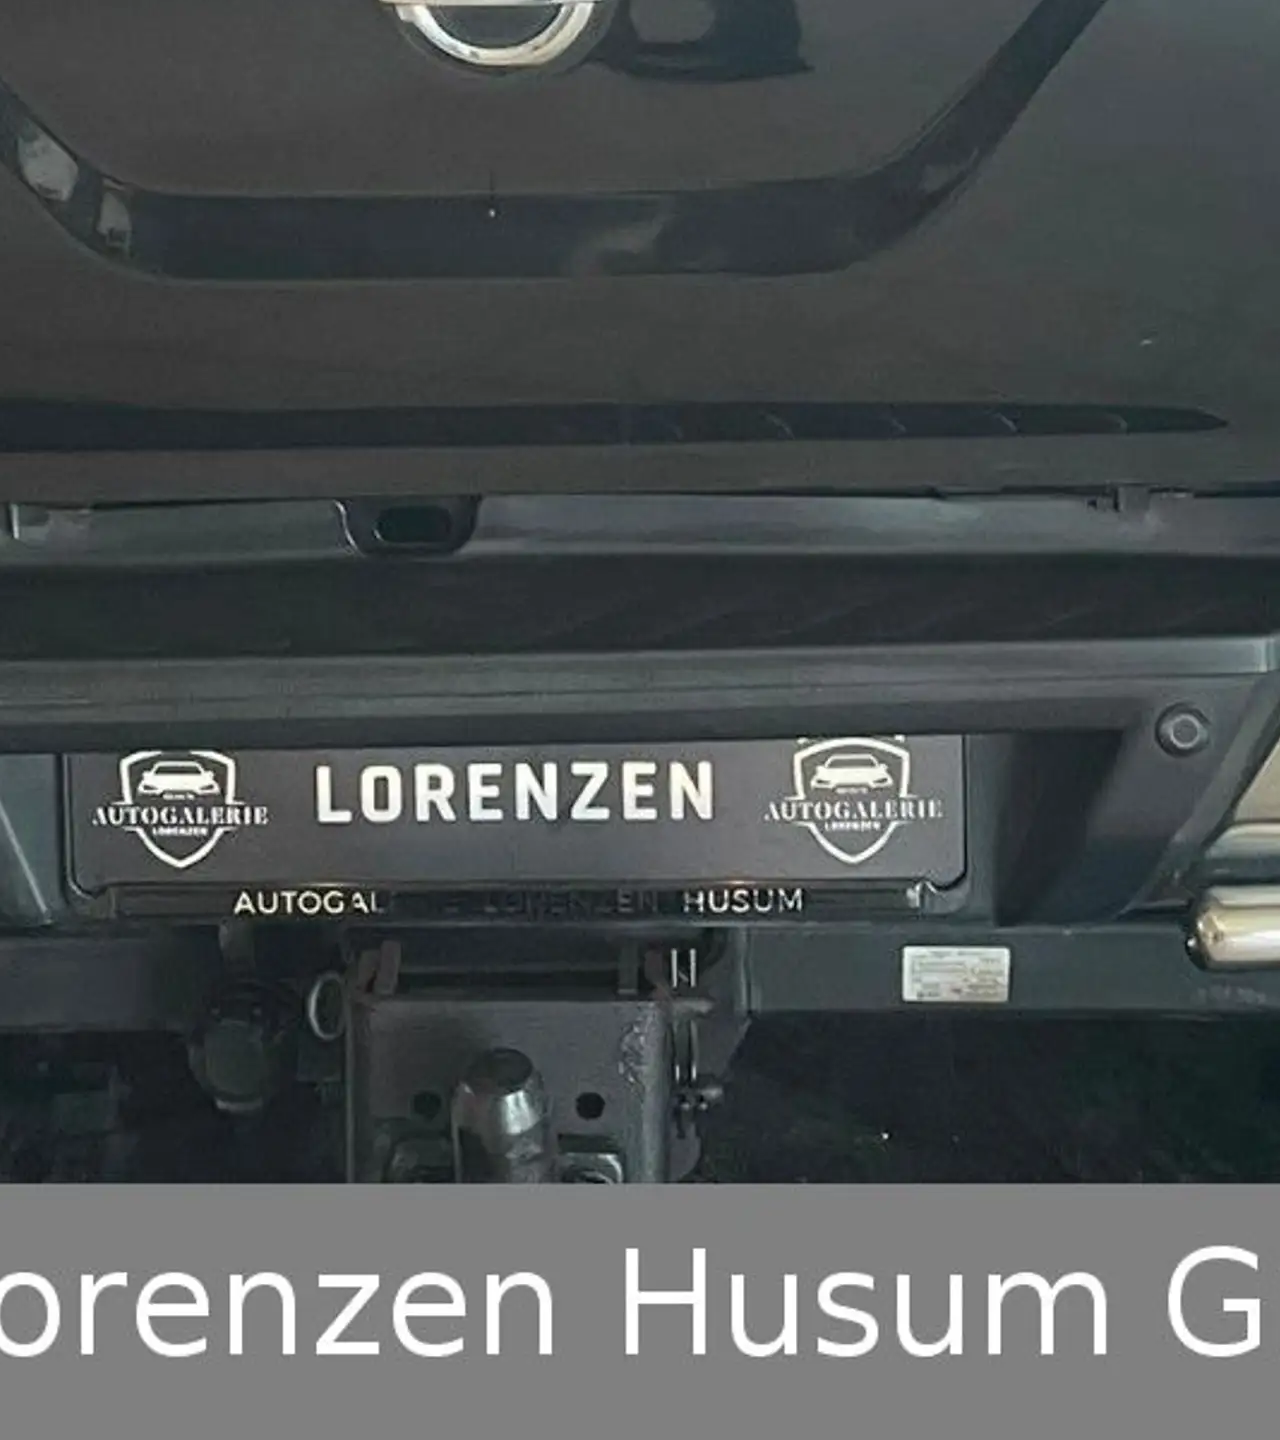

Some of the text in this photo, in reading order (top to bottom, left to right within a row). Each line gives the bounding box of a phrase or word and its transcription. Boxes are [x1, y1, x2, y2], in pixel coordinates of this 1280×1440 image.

[316, 760, 714, 823] LORENZEN
[92, 806, 269, 825] AUTOGALERIE
[764, 800, 943, 821] AUTOGALERIE
[233, 890, 390, 915] AUTOGAL
[683, 888, 803, 914] HUSUM
